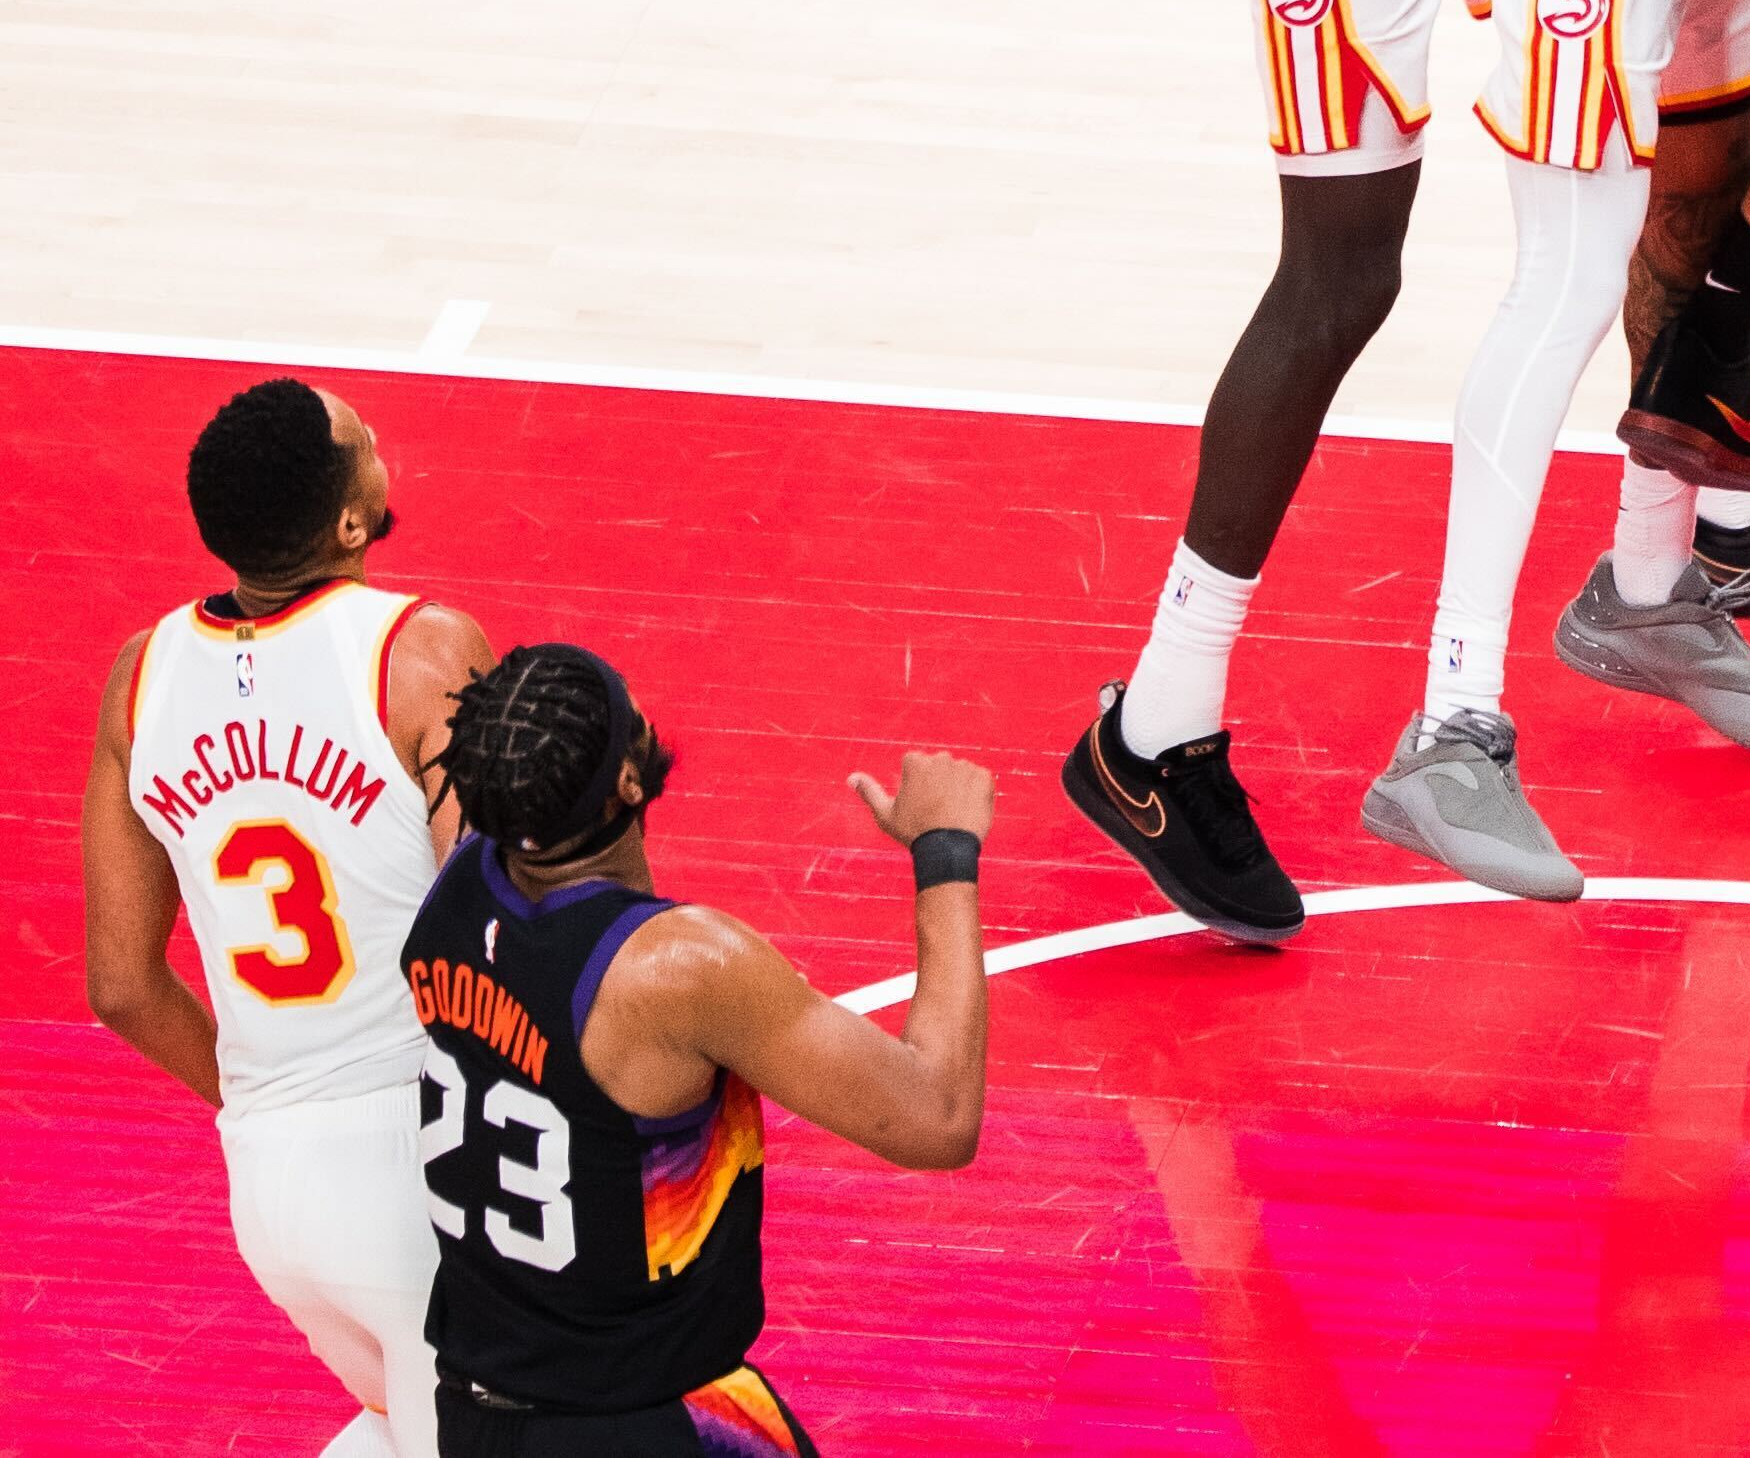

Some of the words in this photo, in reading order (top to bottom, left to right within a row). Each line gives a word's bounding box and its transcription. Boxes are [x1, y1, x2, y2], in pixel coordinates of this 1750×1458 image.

[143, 718, 388, 839] McCOLLUM
[211, 817, 357, 1009] 3
[409, 957, 549, 1086] GOODWIN
[420, 1034, 577, 1274] 23
